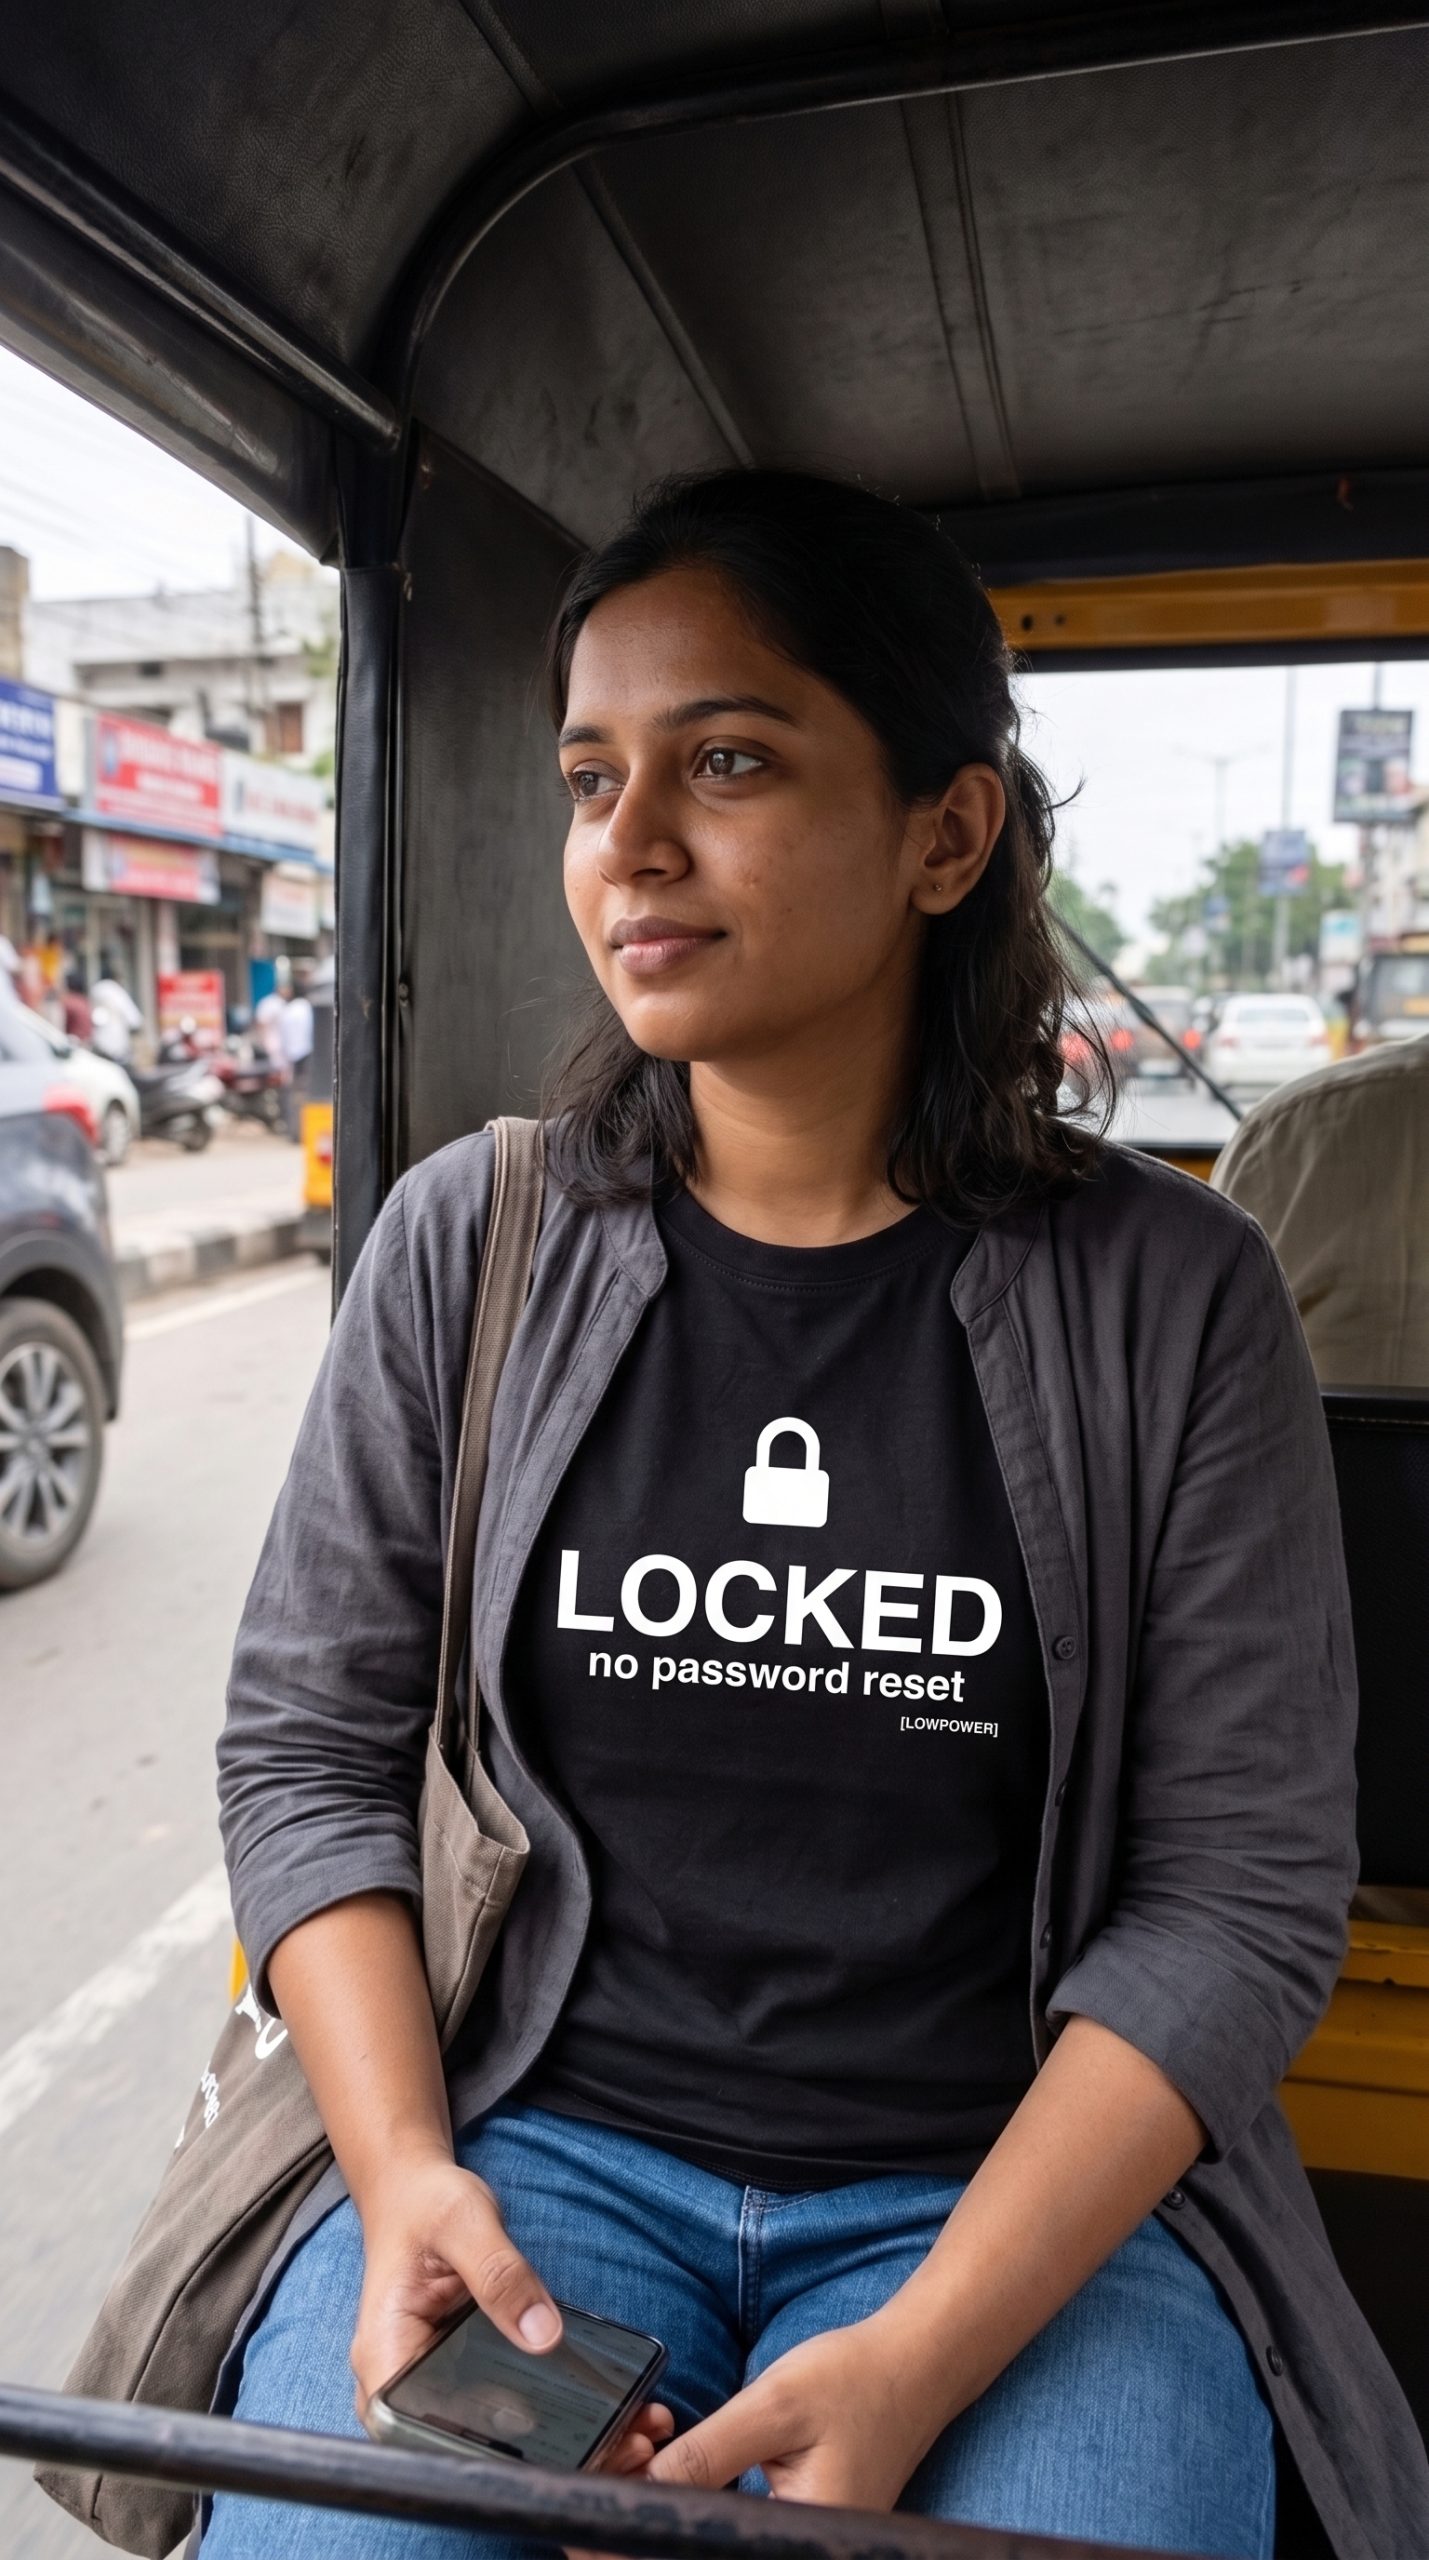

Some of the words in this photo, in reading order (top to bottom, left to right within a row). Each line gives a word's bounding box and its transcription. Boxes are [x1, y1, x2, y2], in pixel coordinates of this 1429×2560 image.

[557, 1549, 1003, 1657] LOCKED
[589, 1652, 639, 1680] no
[651, 1656, 850, 1694] password
[863, 1670, 966, 1703] reset
[900, 1716, 999, 1738] [LOWPOWER]
